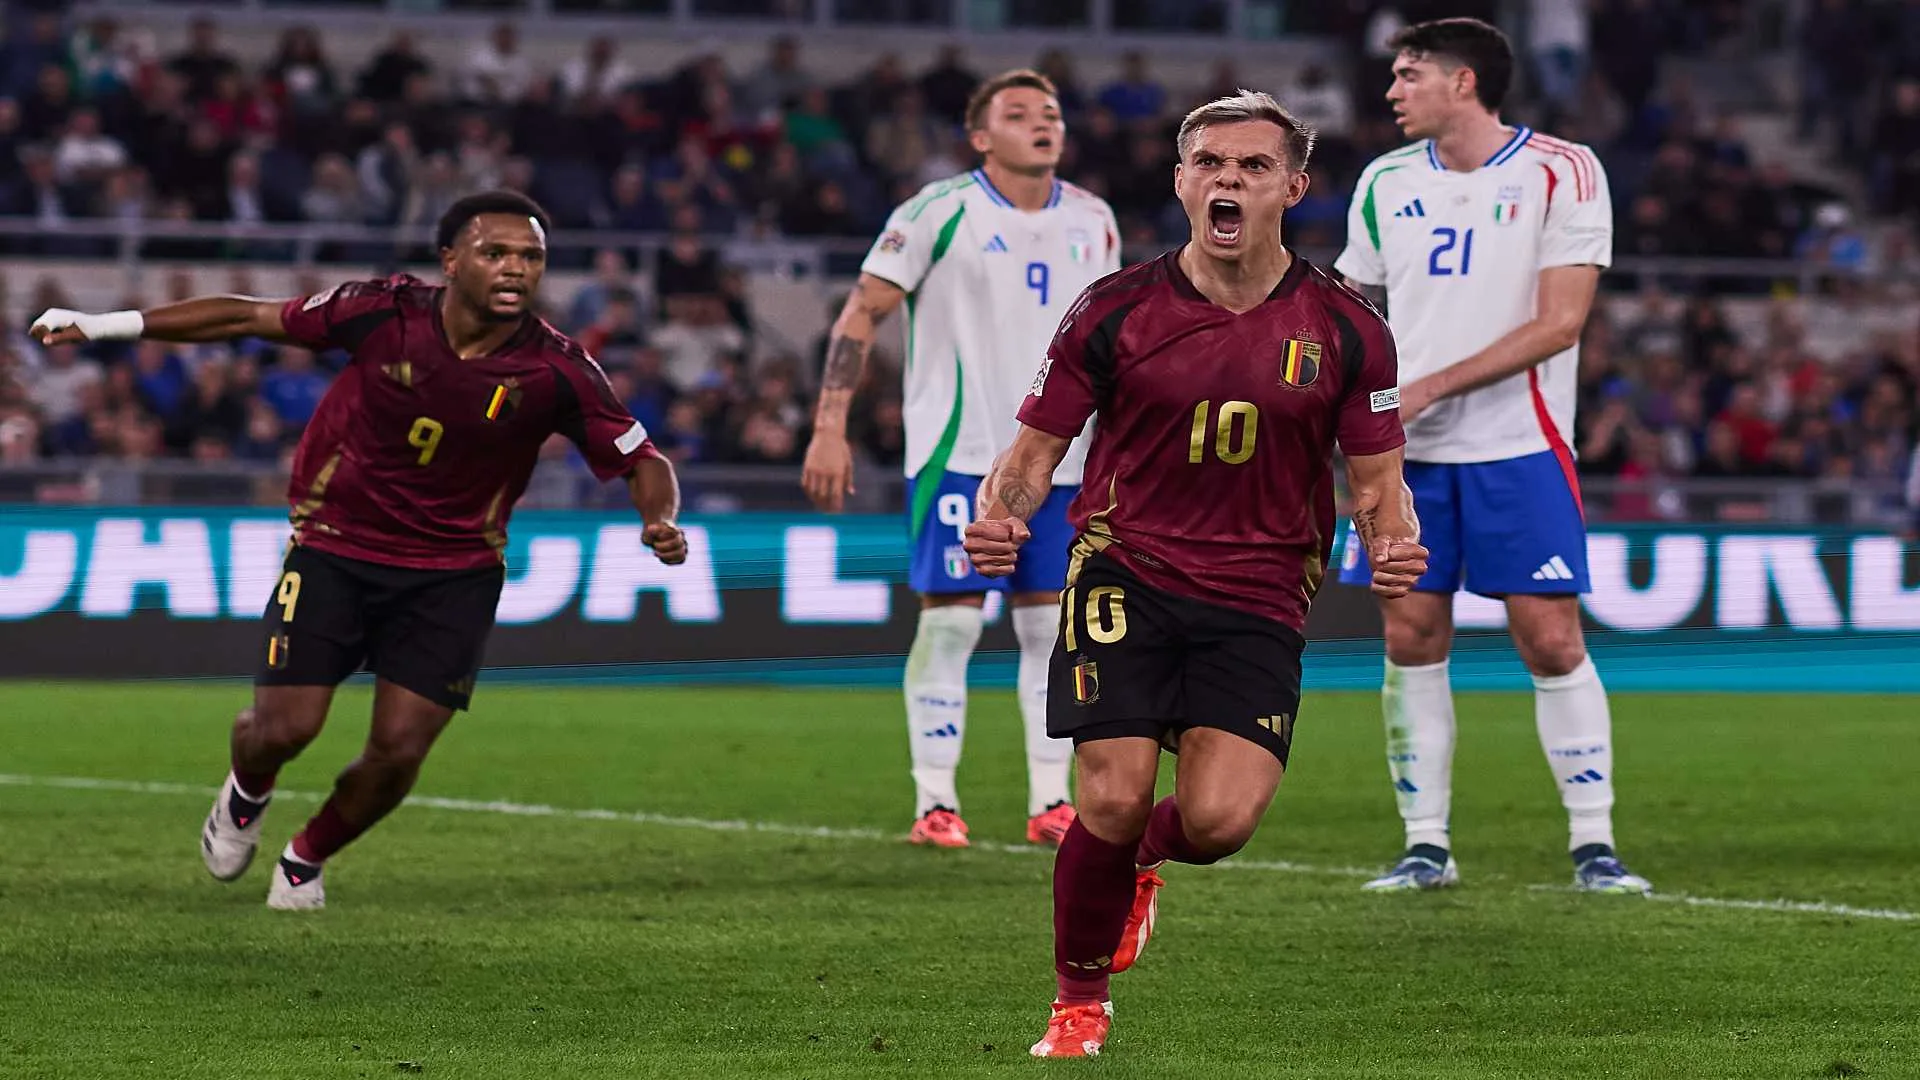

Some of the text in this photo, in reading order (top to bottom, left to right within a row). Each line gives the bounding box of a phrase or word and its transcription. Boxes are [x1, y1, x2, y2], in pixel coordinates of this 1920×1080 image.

[1429, 227, 1473, 275] 21
[1026, 262, 1049, 306] 9
[407, 416, 443, 466] 9
[1188, 399, 1259, 465] 10
[937, 492, 970, 542] 9
[277, 570, 301, 622] 9
[1065, 585, 1128, 653] 10
